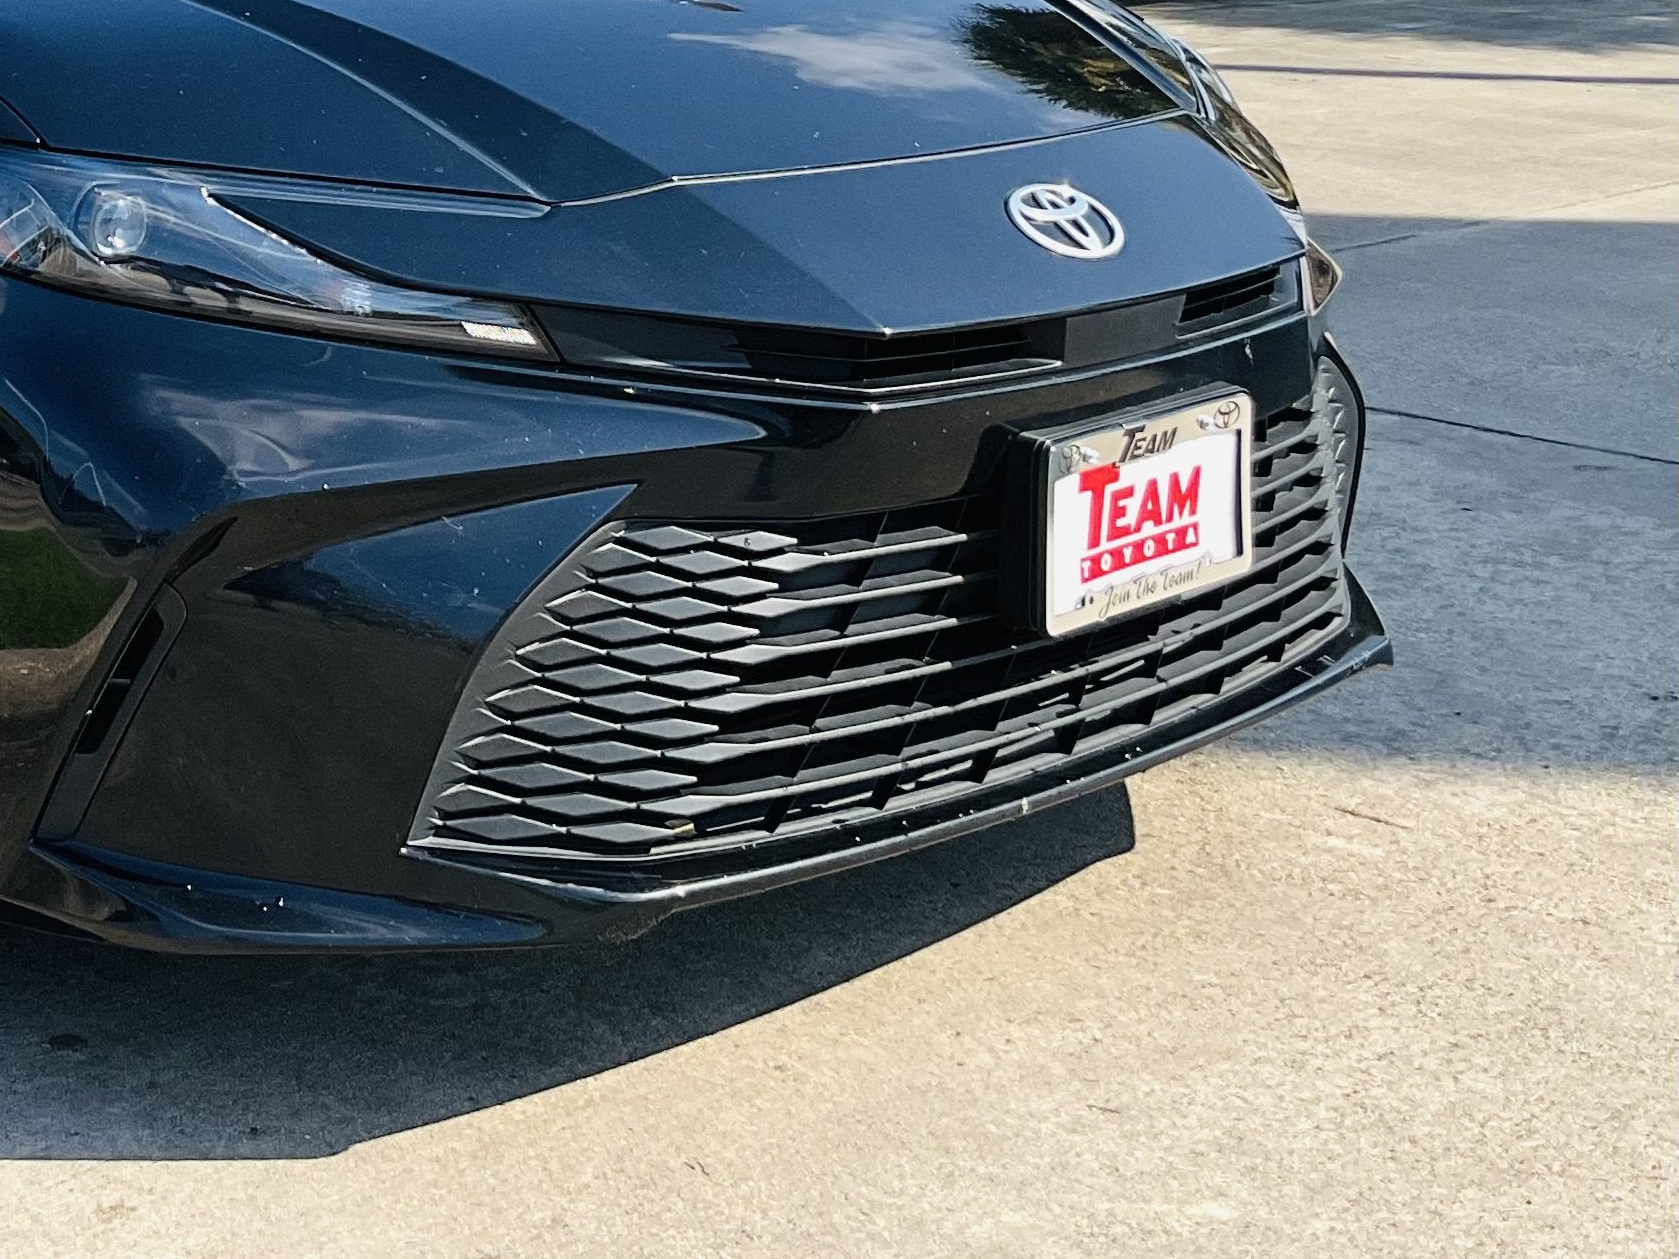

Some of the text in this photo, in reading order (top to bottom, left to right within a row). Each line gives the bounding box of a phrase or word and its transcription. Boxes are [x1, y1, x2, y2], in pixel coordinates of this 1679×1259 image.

[1113, 425, 1179, 468] TEAM
[1078, 462, 1202, 551] TEAM
[1080, 526, 1198, 580] TOYOTA
[1098, 585, 1131, 619] Join
[1133, 574, 1158, 600] The
